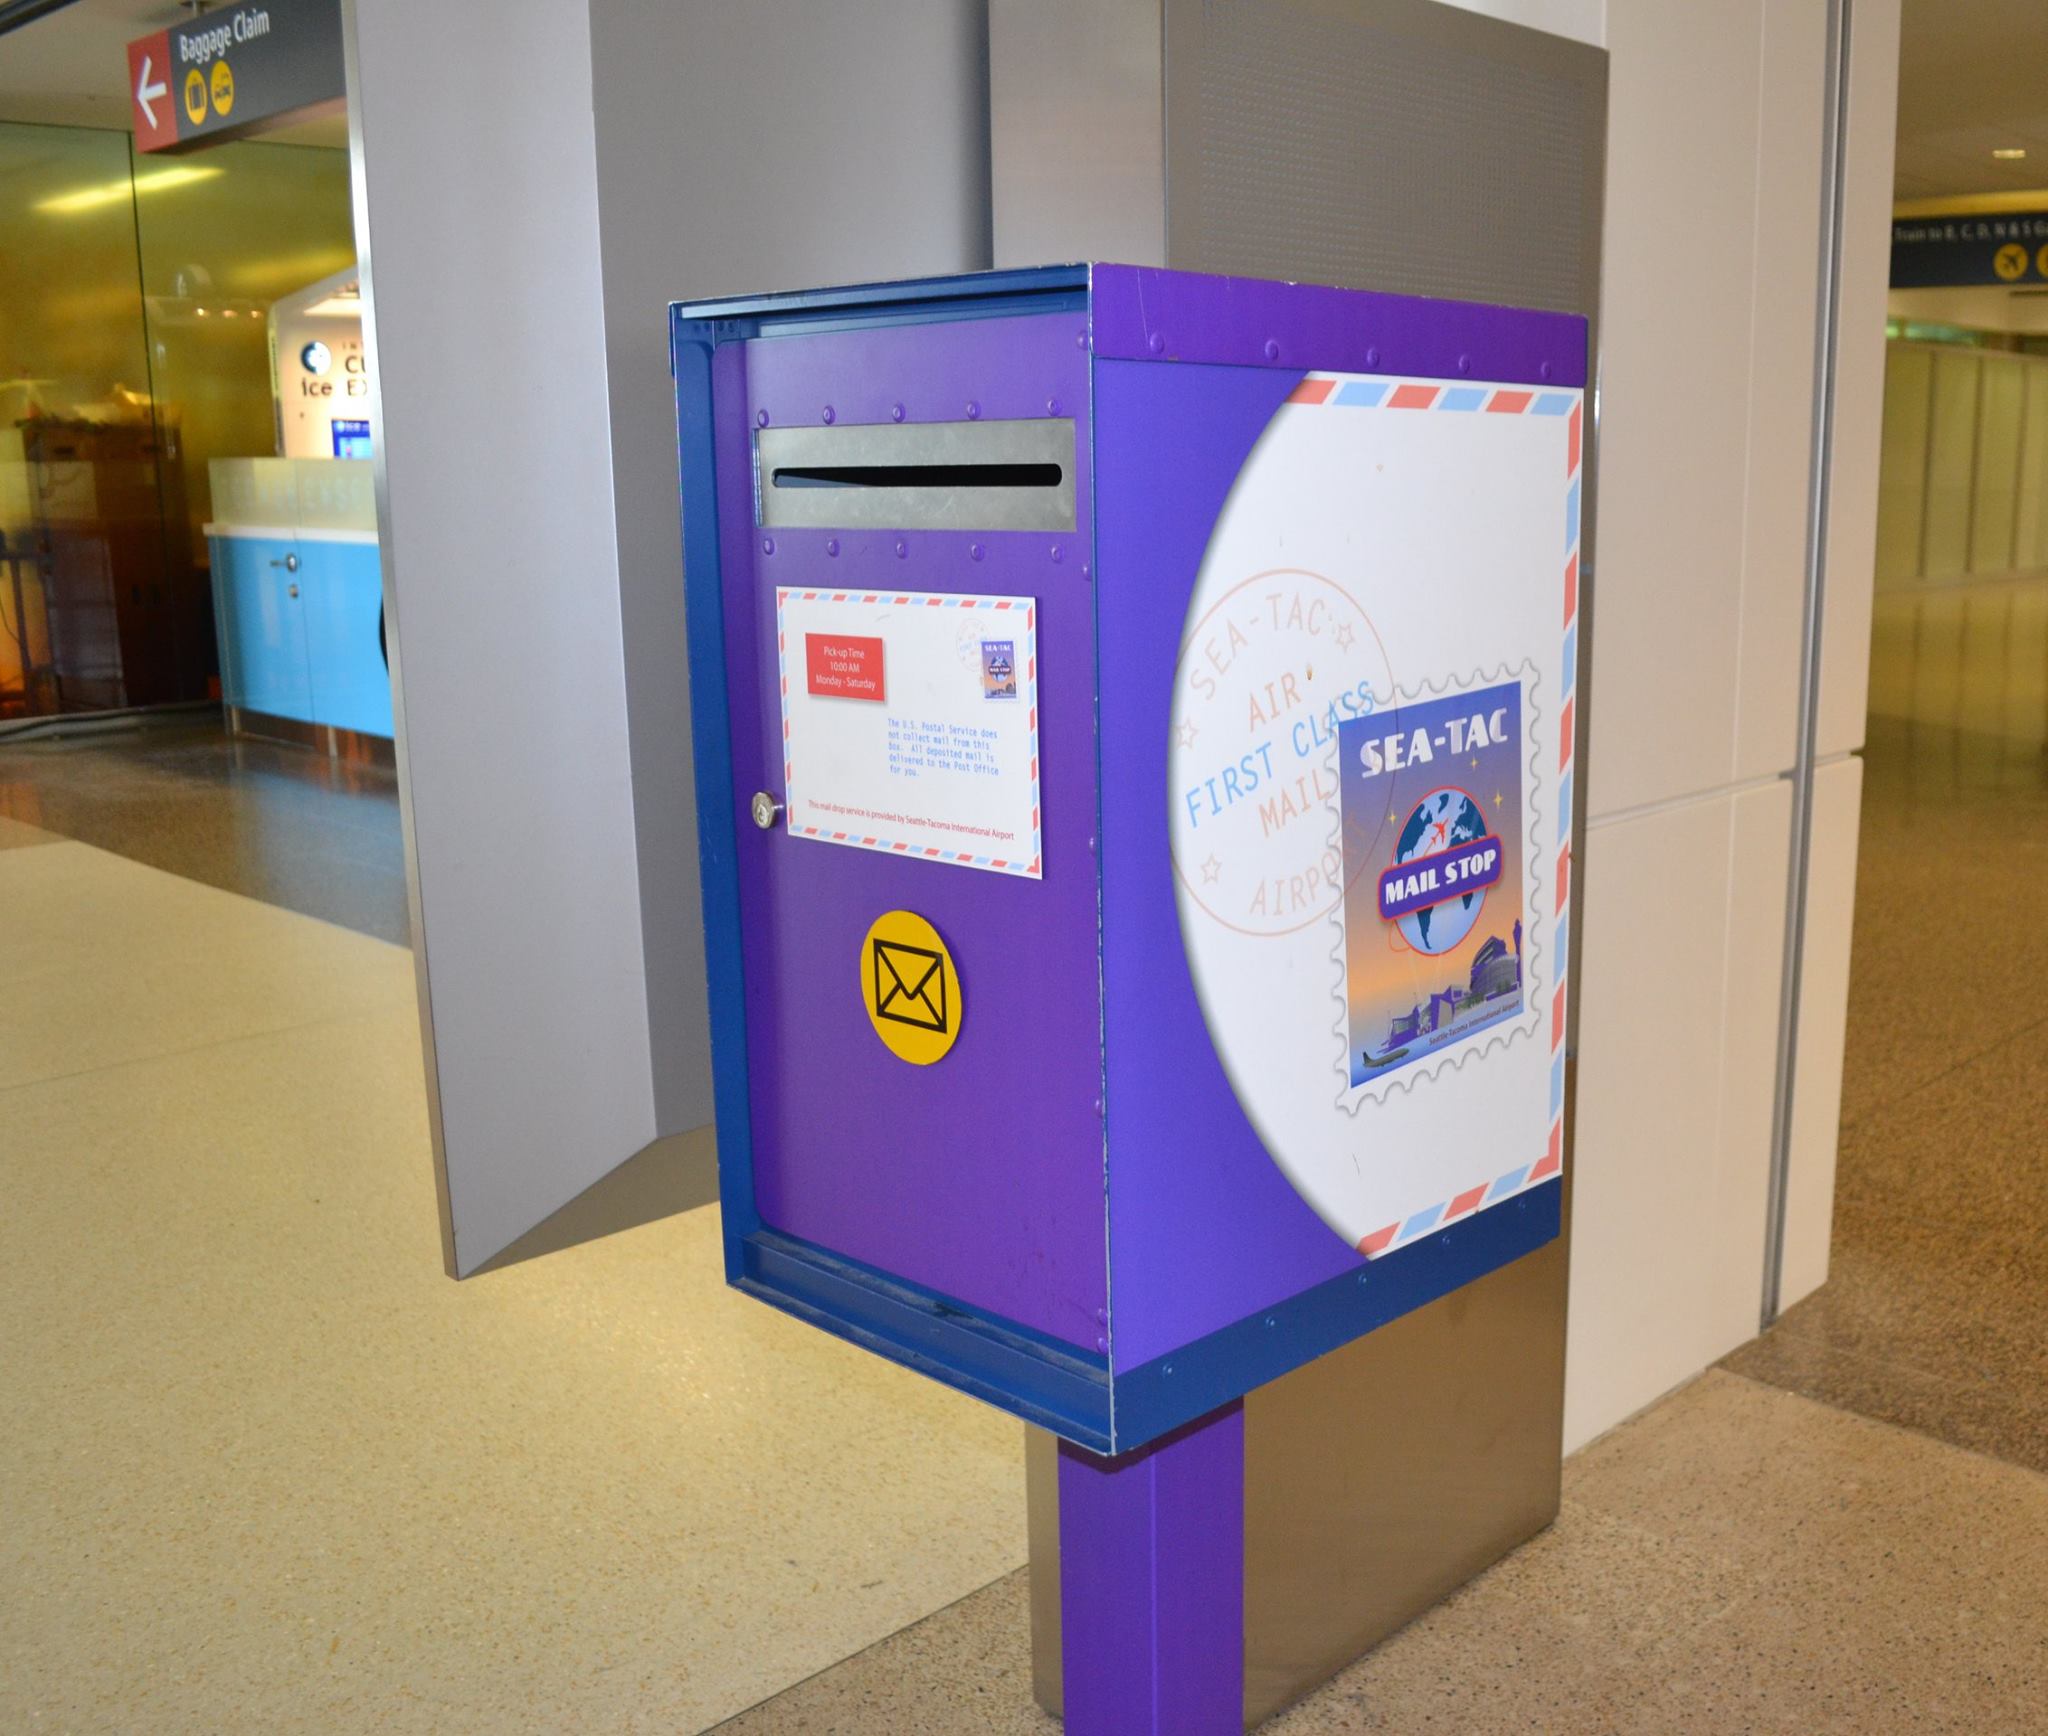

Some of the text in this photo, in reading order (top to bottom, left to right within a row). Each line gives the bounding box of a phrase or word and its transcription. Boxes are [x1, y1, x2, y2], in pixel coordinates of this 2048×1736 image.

[180, 8, 270, 64] Baggage Claim
[823, 646, 865, 660] Pick-up Time
[830, 661, 860, 673] 10:00 AM
[1190, 592, 1325, 701] SEA-TAC
[816, 674, 842, 688] Monday
[846, 677, 876, 692] Saturday
[1249, 671, 1301, 733] AIR
[888, 718, 899, 727] The
[922, 722, 945, 733] Postal
[949, 724, 977, 737] Service
[981, 728, 998, 739] does
[888, 731, 989, 750] not collect mail from this
[1359, 707, 1508, 779] SEA-TAC
[889, 753, 999, 776] delivered to the Post Office
[890, 765, 901, 774] for
[911, 744, 922, 753] All
[927, 747, 962, 760] deposited
[965, 751, 981, 760] mail
[986, 753, 994, 762] is
[1185, 680, 1375, 828] FIRST CLASS
[808, 799, 819, 809] This
[820, 802, 831, 811] mail
[832, 804, 845, 815] drop
[846, 808, 865, 817] service
[871, 811, 896, 822] provided
[898, 814, 905, 824] by
[906, 815, 950, 830] Seattle-Tacoma
[951, 822, 991, 836] International
[992, 829, 1014, 841] Airport
[1258, 768, 1331, 839] MAIL
[1385, 849, 1496, 905] MAIL STOP
[1429, 1000, 1520, 1046] Seattle-Tacoma International Airport
